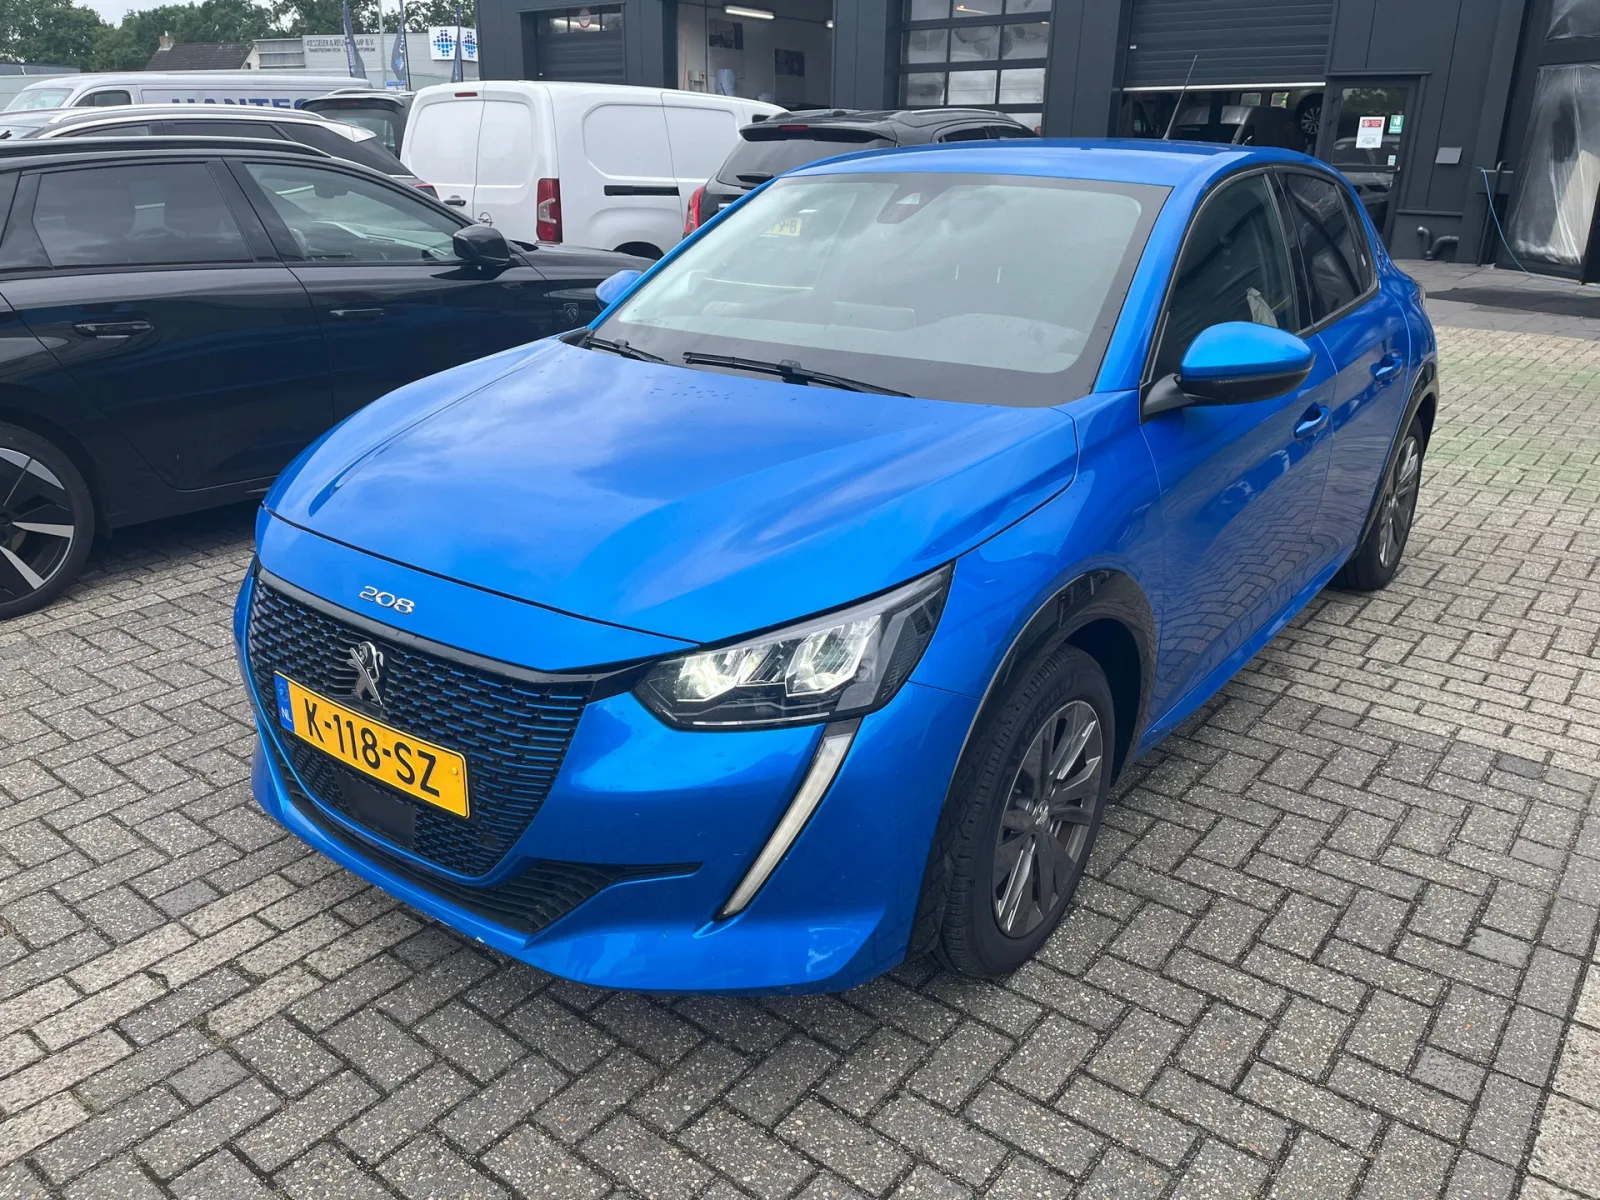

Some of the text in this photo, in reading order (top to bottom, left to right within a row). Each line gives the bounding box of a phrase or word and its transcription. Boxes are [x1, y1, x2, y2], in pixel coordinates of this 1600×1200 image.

[359, 585, 415, 615] 208
[281, 707, 293, 723] NL
[304, 697, 441, 798] K-118-SZ
